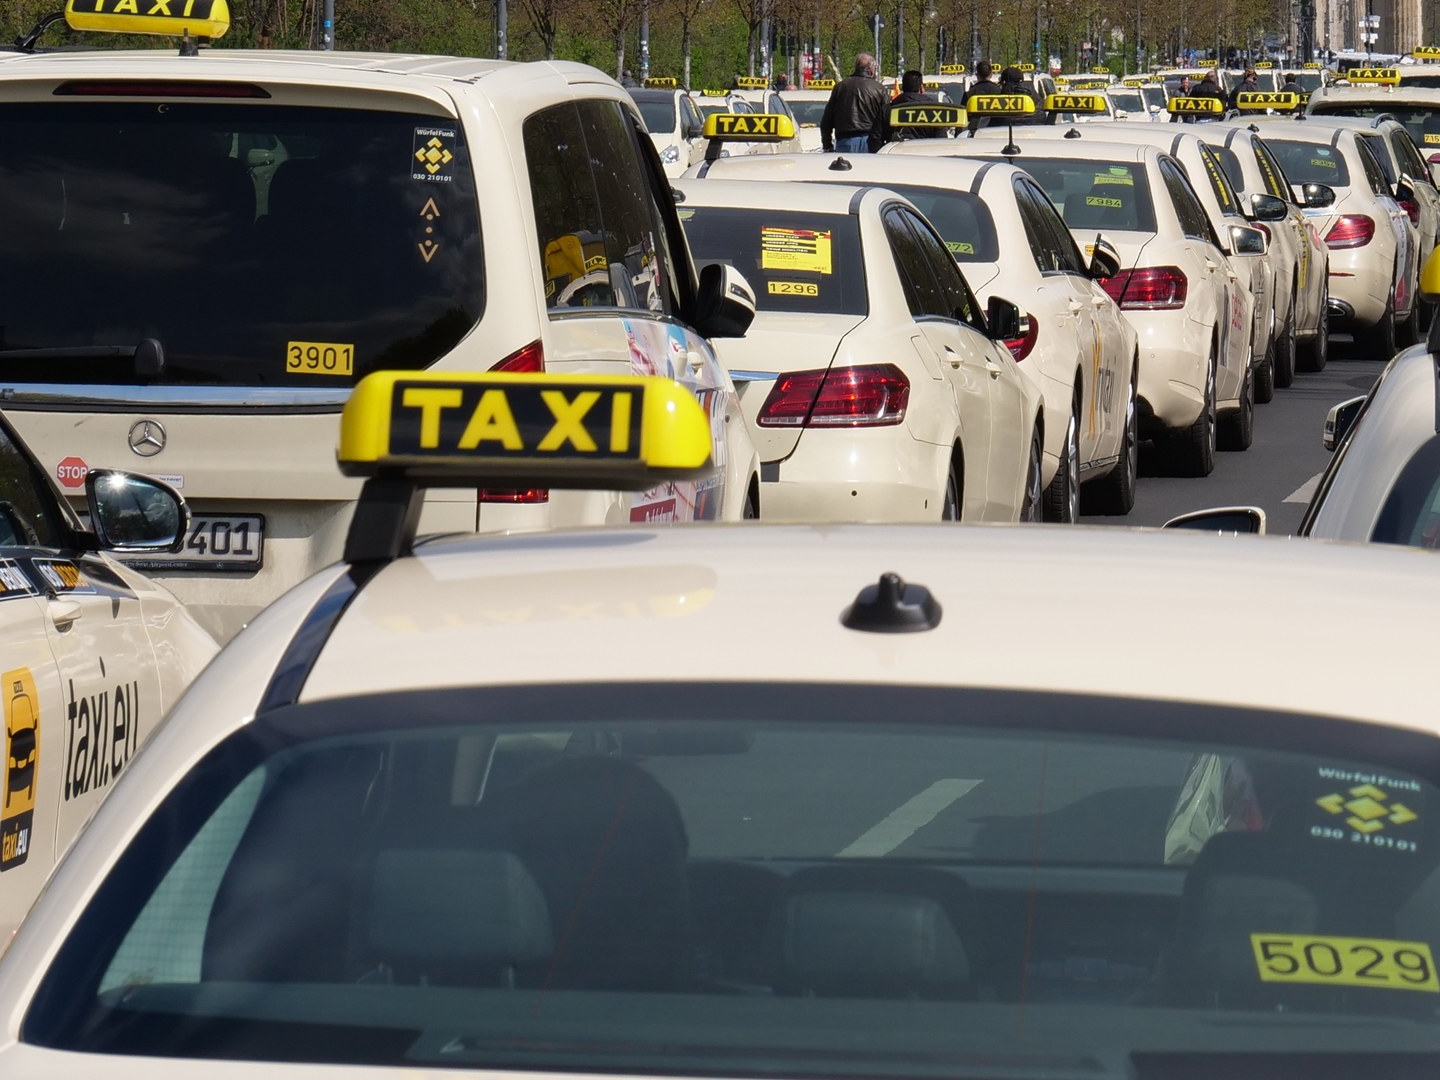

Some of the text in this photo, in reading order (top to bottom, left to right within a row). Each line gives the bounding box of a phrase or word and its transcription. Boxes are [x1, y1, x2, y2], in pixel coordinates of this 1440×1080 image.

[1355, 70, 1391, 78] TAXI
[979, 98, 1022, 110] TAXI
[1055, 97, 1093, 108] TAXI
[1177, 100, 1212, 110] TAXI
[1246, 94, 1285, 103] TAXI
[906, 110, 950, 123] TAXI
[719, 117, 775, 133] TAXI
[417, 130, 455, 138] WürfelFunk
[427, 174, 452, 182] 210101
[1087, 197, 1121, 207] 7984
[769, 283, 817, 295] 1296
[288, 345, 353, 371] 3901
[402, 387, 633, 453] TAXI
[58, 465, 88, 479] STOP
[169, 521, 253, 555] 401
[64, 656, 139, 802] taxi.eu
[1318, 766, 1422, 792] WürfelFunk
[2, 822, 29, 863] taxi.eu
[1310, 825, 1418, 852] 030 210101
[1260, 940, 1431, 985] 5029
